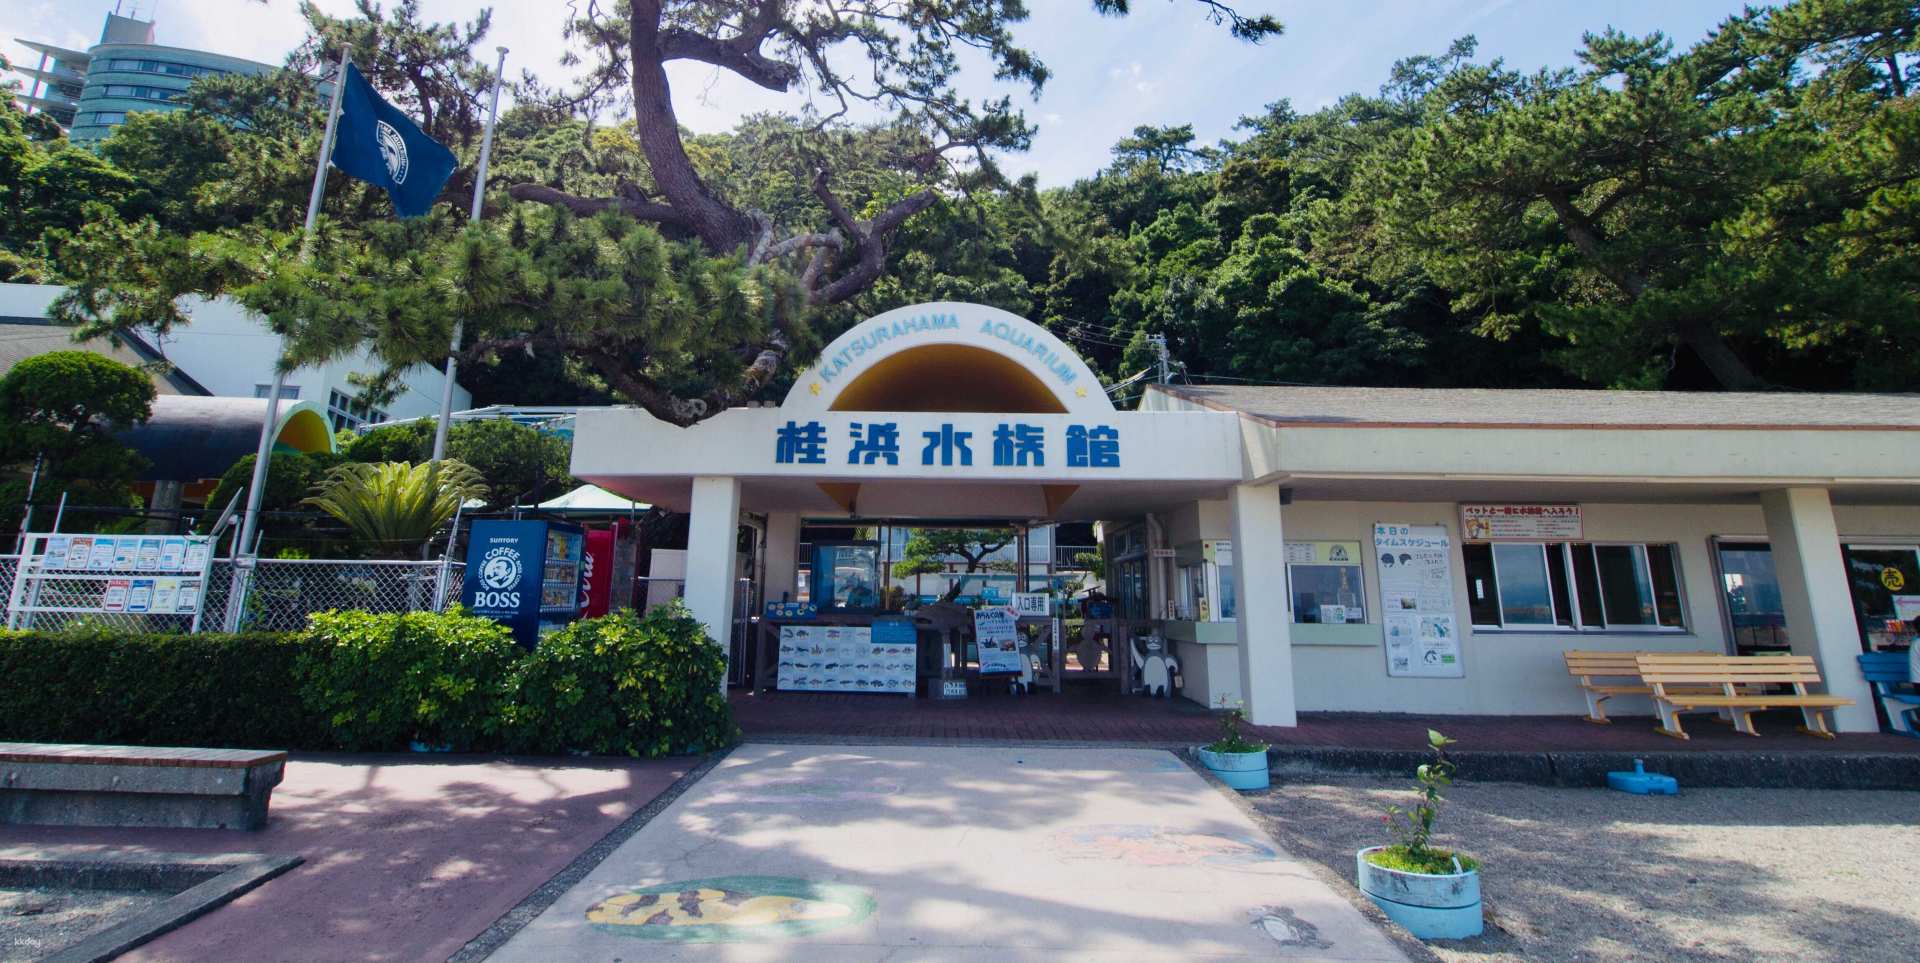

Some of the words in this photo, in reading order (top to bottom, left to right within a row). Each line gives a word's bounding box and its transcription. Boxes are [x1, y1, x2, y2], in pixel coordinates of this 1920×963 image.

[820, 313, 960, 383] KATSURAHAMA
[978, 318, 1077, 385] AQUARIUM
[775, 420, 1121, 468] 桂浜水族館
[1376, 526, 1409, 536] 本日の
[1375, 537, 1449, 549] タイムスケジュール
[484, 546, 521, 561] COFFEE
[473, 591, 520, 608] BOSS
[1017, 596, 1046, 613] 入口専用
